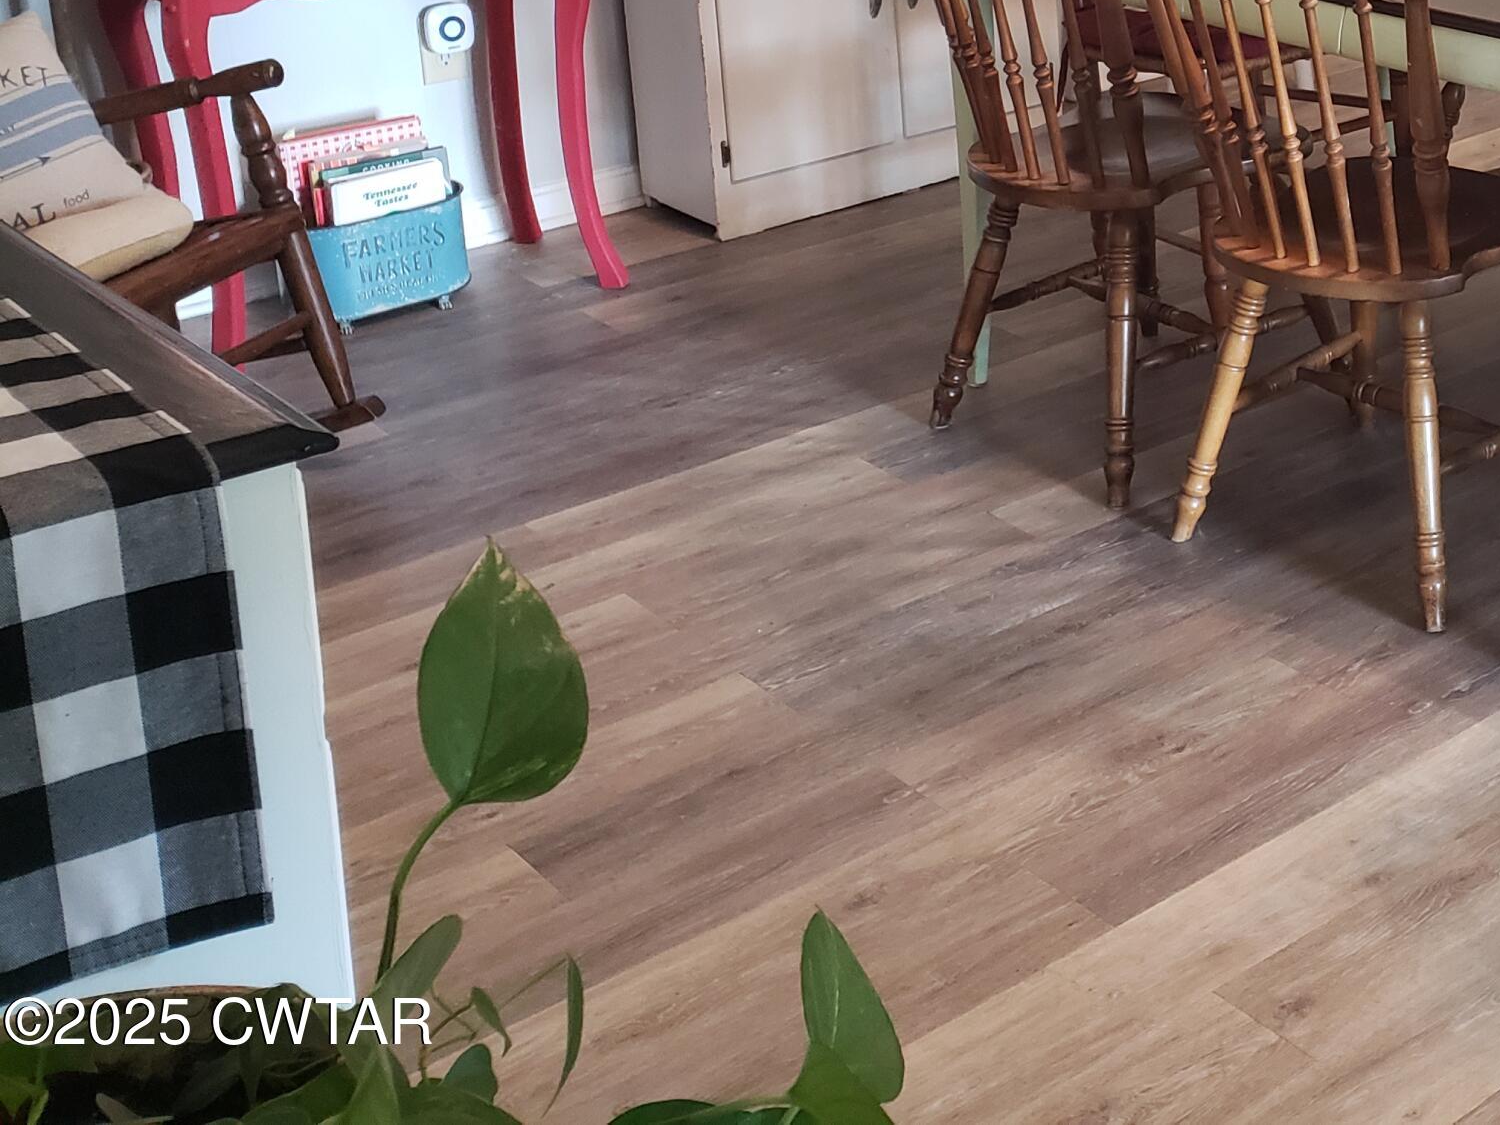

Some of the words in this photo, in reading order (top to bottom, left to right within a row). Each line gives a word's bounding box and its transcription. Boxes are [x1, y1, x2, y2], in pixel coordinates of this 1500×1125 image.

[63, 189, 90, 208] food
[362, 181, 418, 201] Tennessee
[374, 194, 409, 207] Tastes
[342, 221, 446, 269] FARMERS
[359, 248, 434, 284] MARKET
